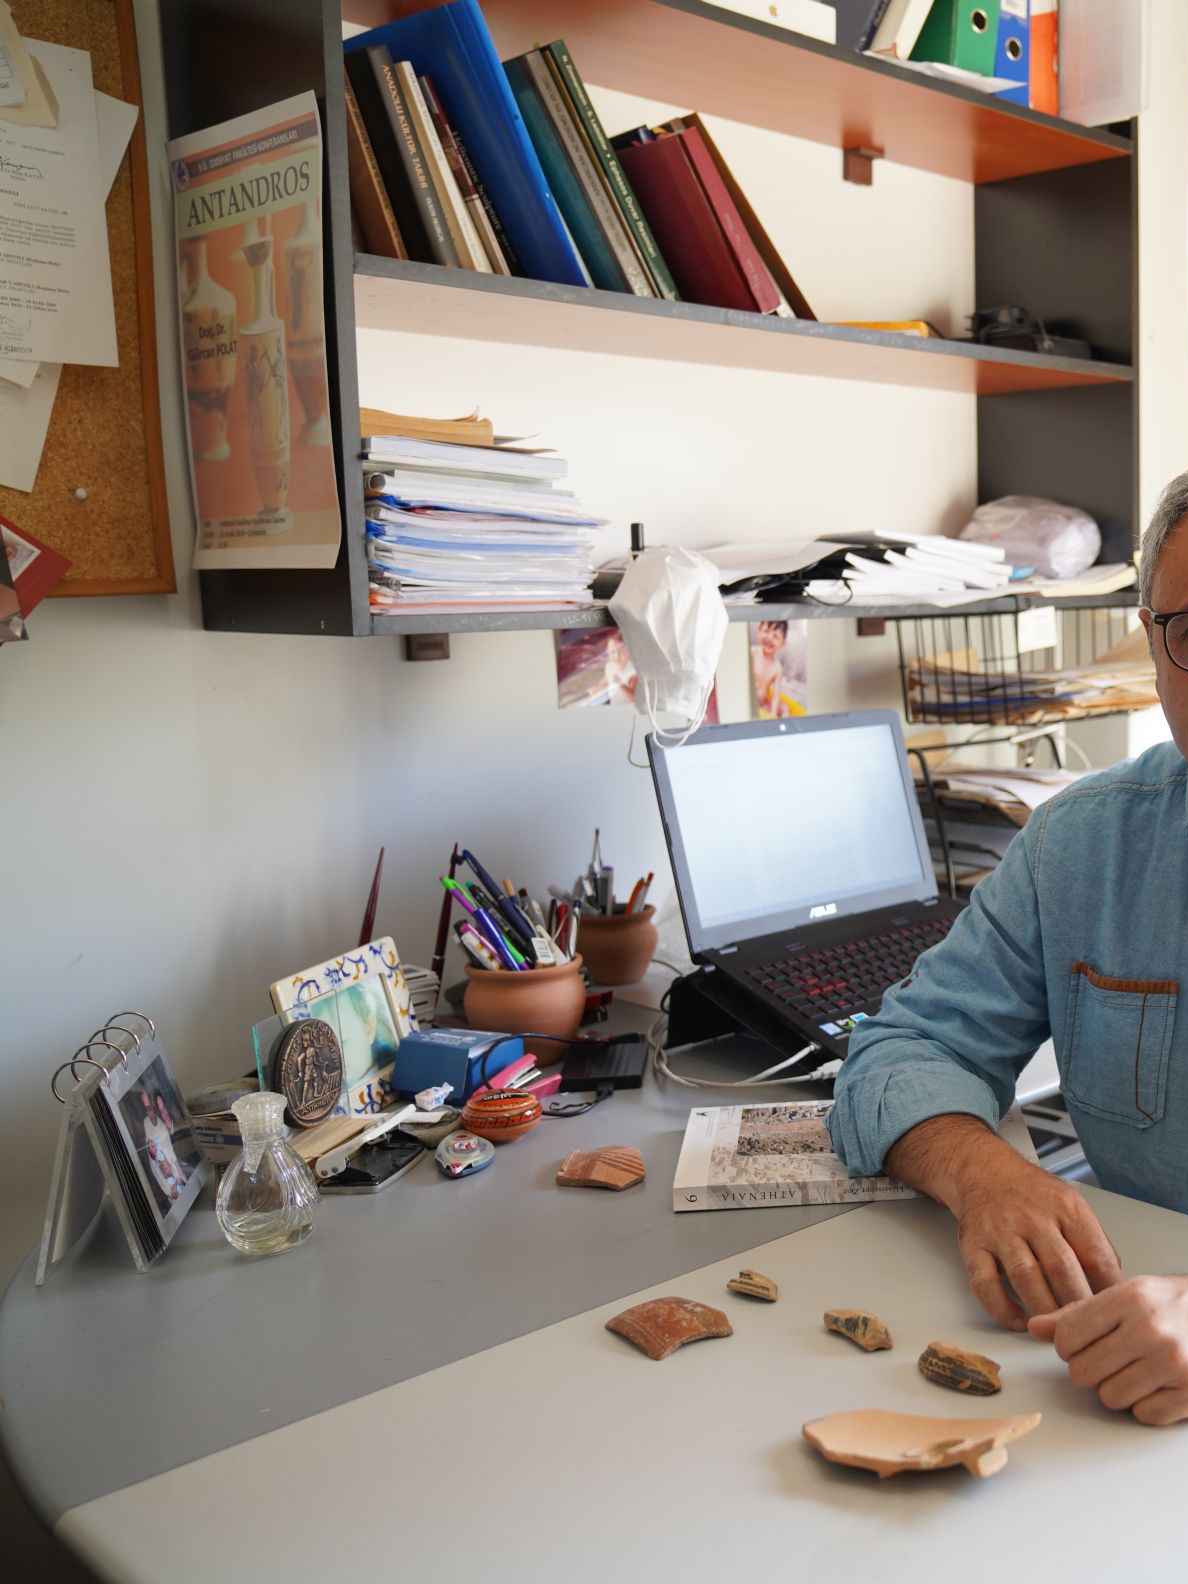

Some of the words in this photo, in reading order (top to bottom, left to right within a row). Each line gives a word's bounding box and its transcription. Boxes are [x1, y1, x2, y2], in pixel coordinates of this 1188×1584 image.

[188, 161, 310, 228] ANTANDROS
[608, 160, 628, 196] Ephesos
[624, 196, 640, 220] Duvar
[216, 341, 238, 356] POLAT
[722, 1190, 796, 1202] ATHENAIA
[844, 1187, 860, 1195] Zeit
